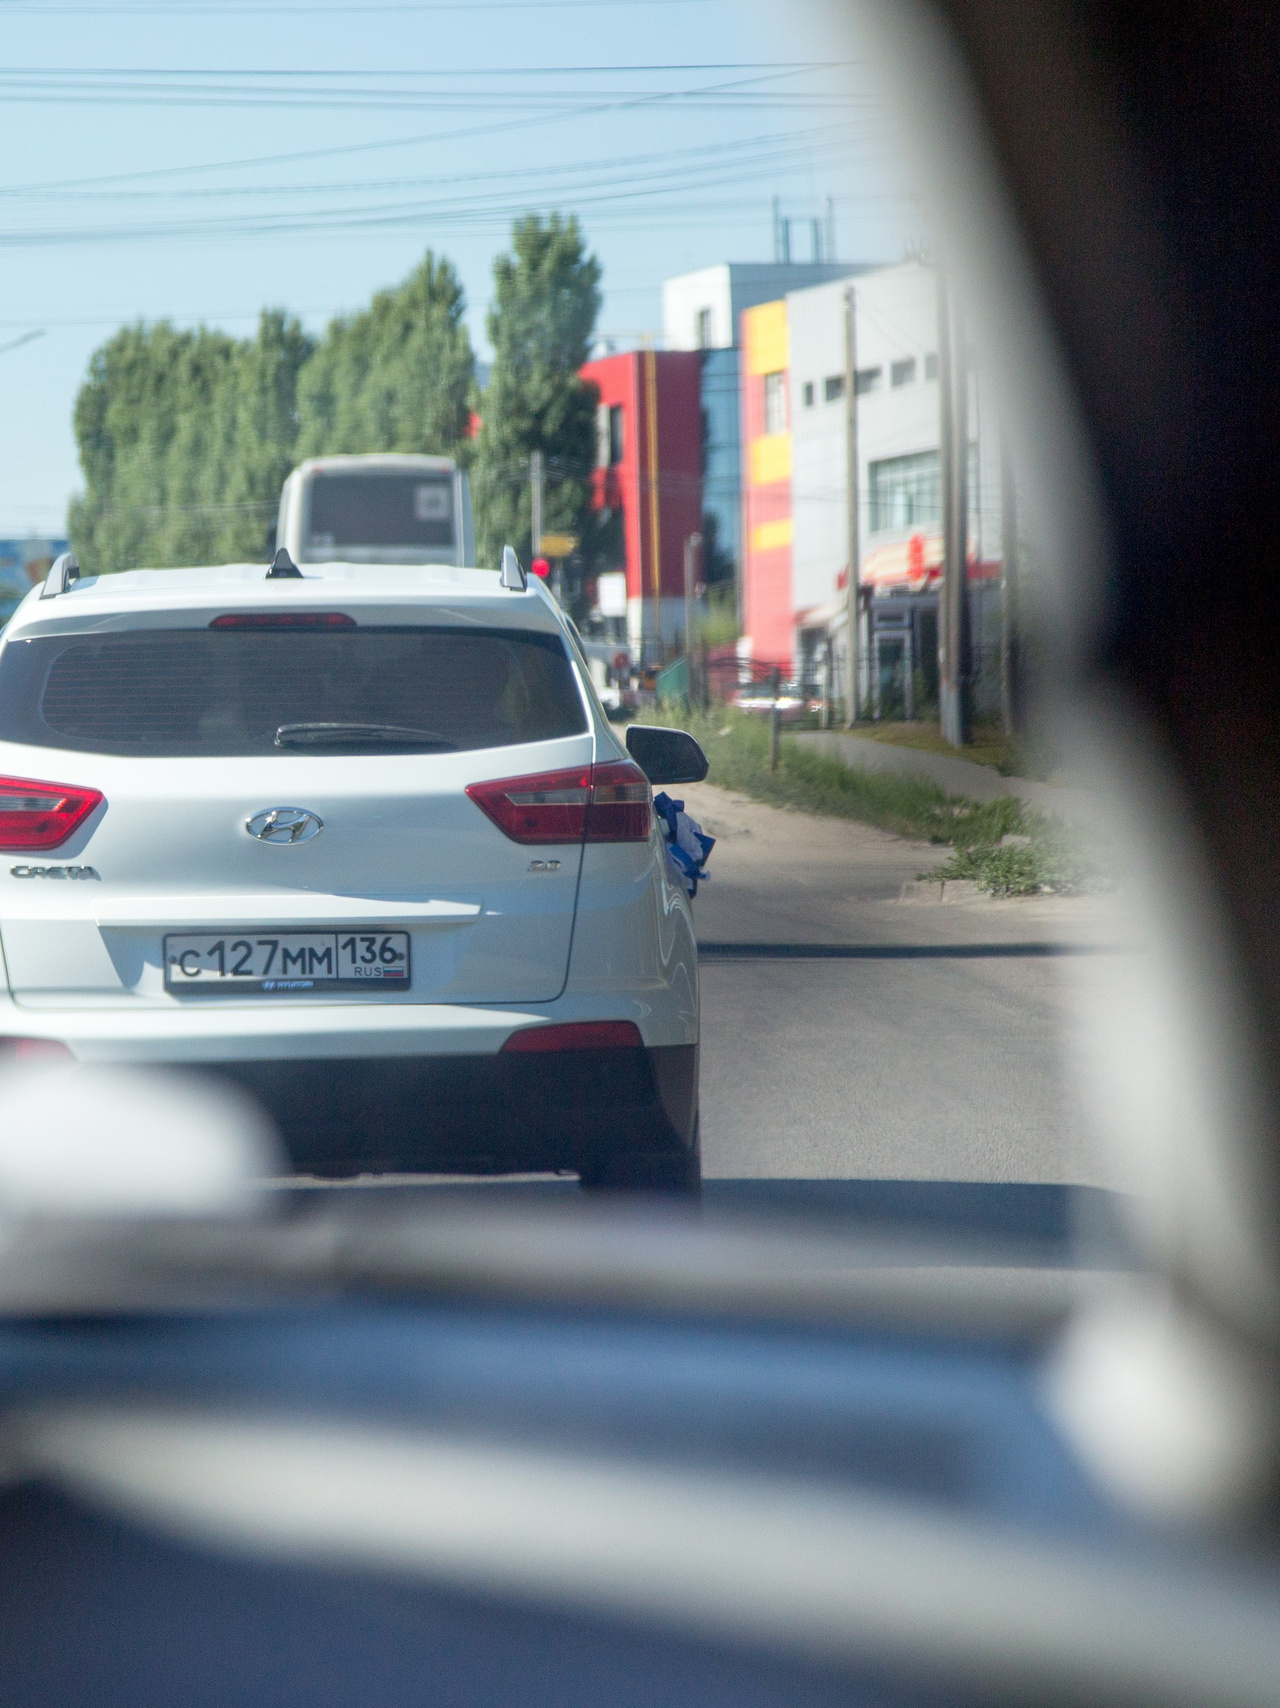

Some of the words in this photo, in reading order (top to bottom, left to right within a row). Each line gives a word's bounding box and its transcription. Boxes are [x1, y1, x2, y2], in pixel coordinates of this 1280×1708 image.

[9, 865, 101, 881] CRETA
[341, 937, 398, 965] 136
[354, 967, 382, 977] RUS
